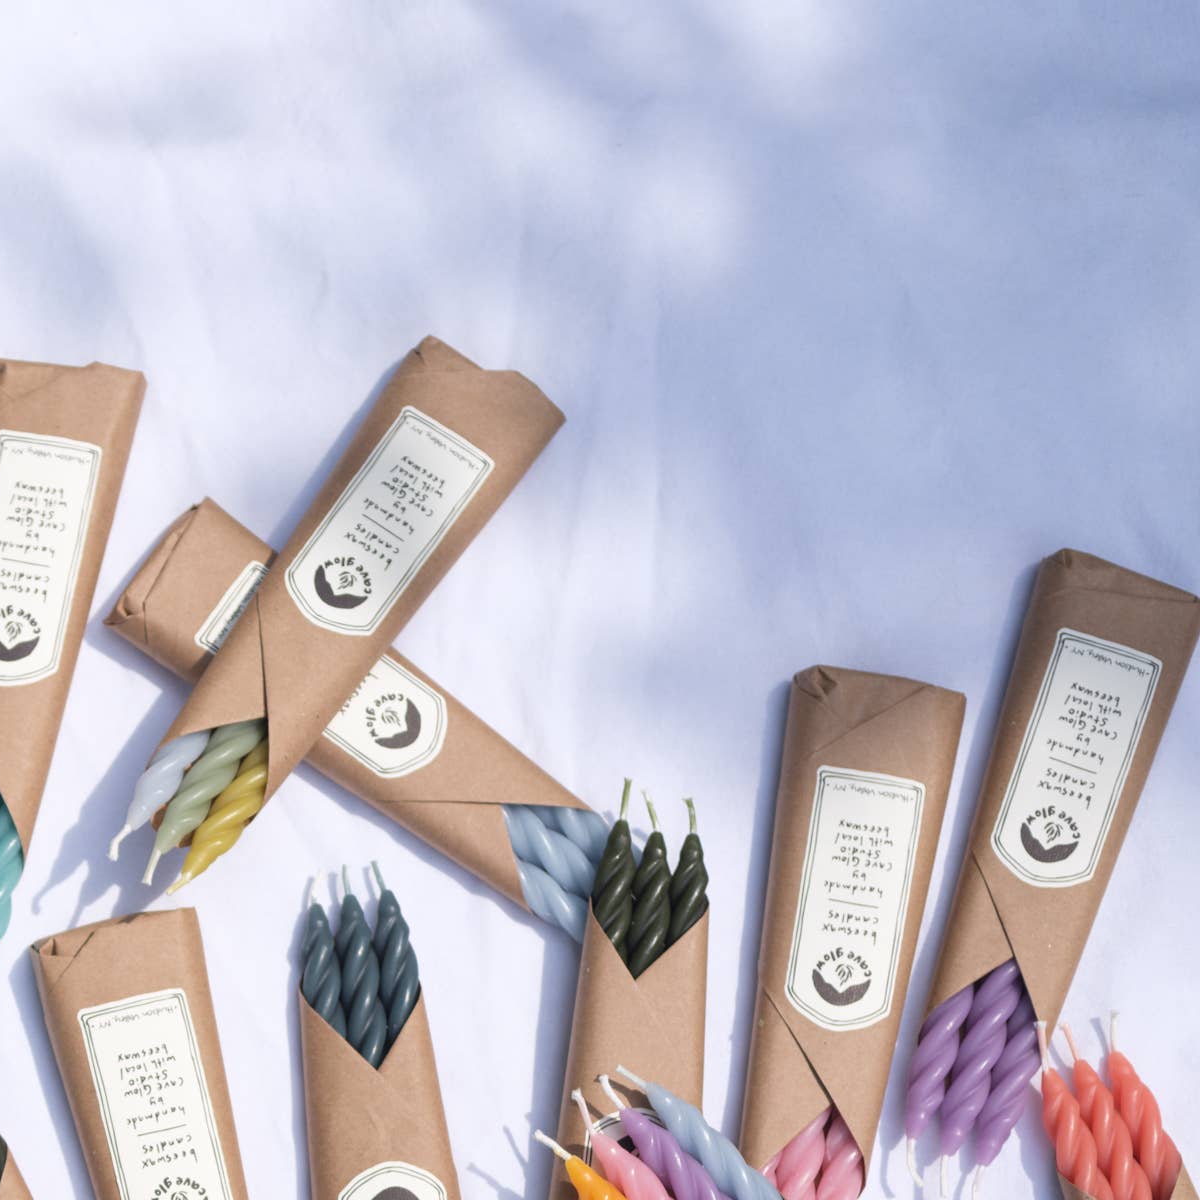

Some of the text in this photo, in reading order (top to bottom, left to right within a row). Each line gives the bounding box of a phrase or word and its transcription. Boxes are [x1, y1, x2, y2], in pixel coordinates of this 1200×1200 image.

[1045, 767, 1096, 789] candles
[1036, 779, 1092, 810] beeswax
[1023, 804, 1081, 840] cave glow
[827, 909, 879, 924] candles
[821, 922, 877, 946] beeswax
[813, 946, 873, 978] cave glow
[141, 1133, 192, 1154] candles
[141, 1147, 198, 1169] beeswax
[175, 1176, 207, 1196] cave
